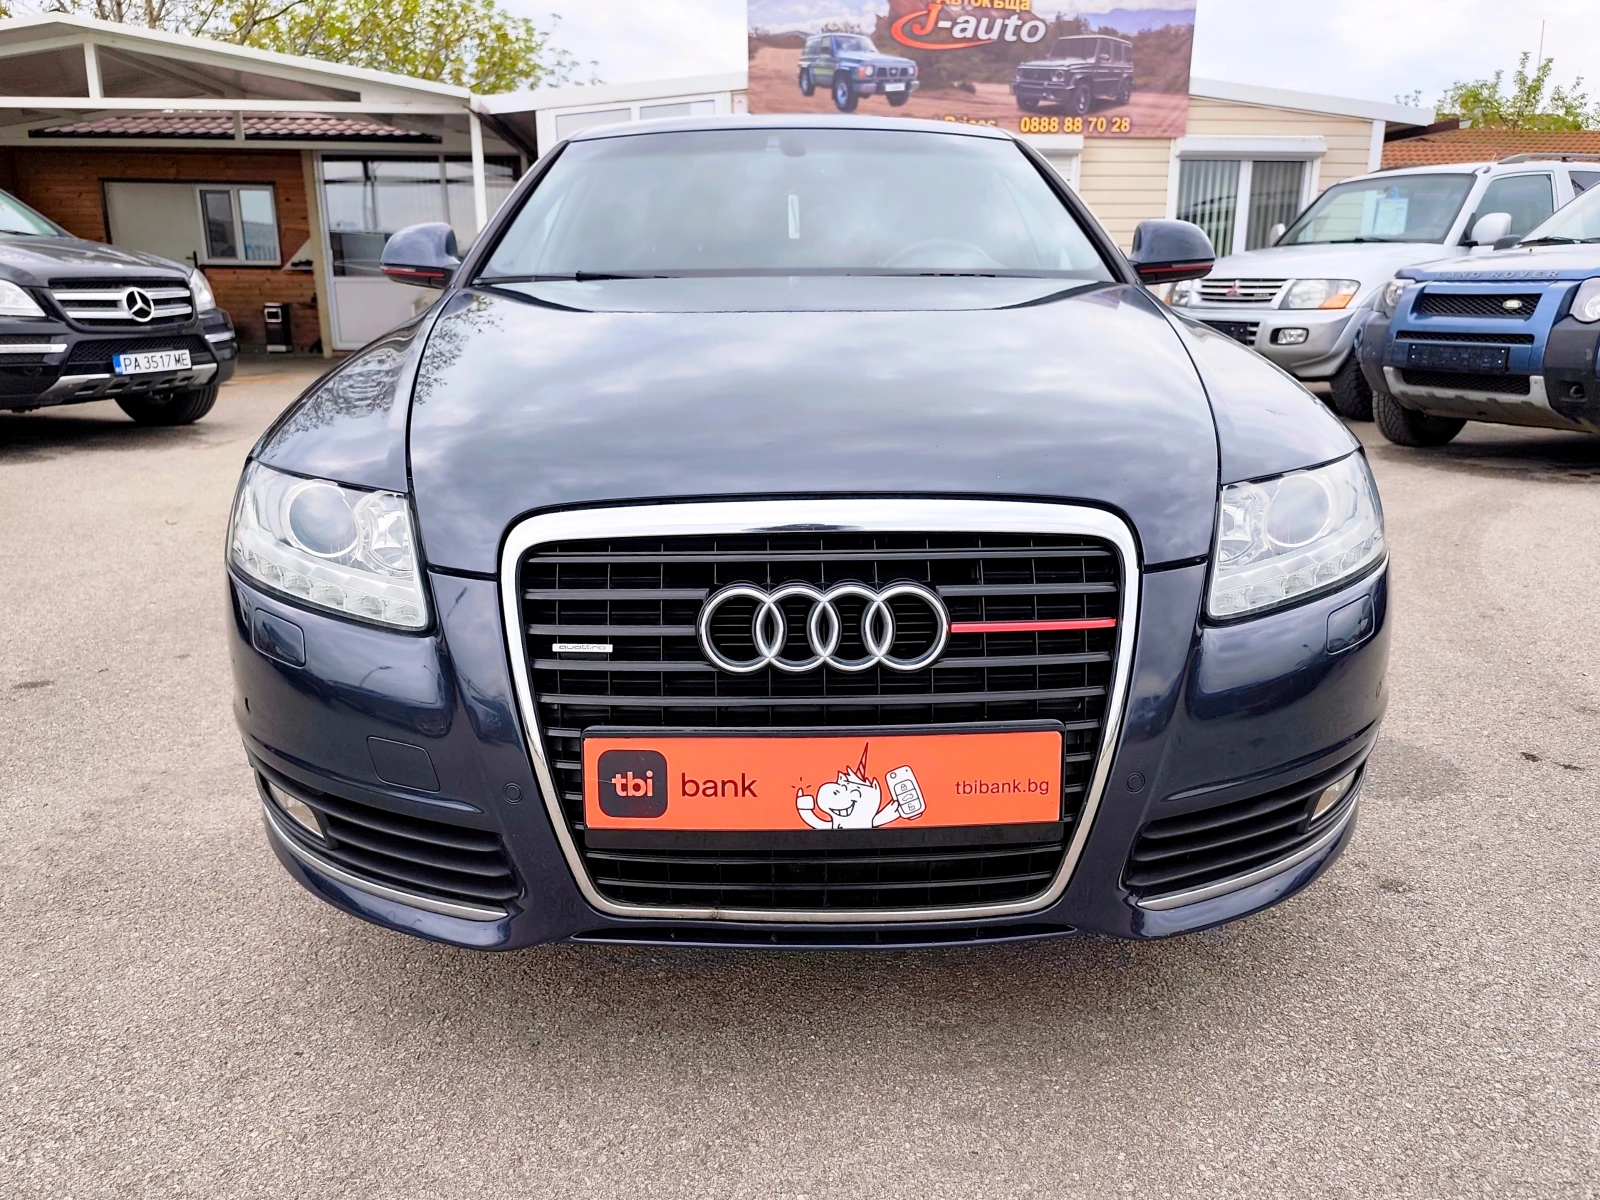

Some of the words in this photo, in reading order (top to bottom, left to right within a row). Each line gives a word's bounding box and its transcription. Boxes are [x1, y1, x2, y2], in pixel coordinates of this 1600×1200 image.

[937, 0, 1030, 12] окъща
[912, 4, 1046, 43] J-auto
[1020, 116, 1058, 132] 0888
[1063, 116, 1082, 132] 88
[1088, 116, 1106, 132] 70
[1111, 116, 1130, 132] 28
[1436, 271, 1480, 279] LAND
[1491, 270, 1559, 279] ROVER
[611, 770, 654, 797] tbi
[681, 772, 758, 798] bank
[955, 778, 1049, 796] tbibank.bg
